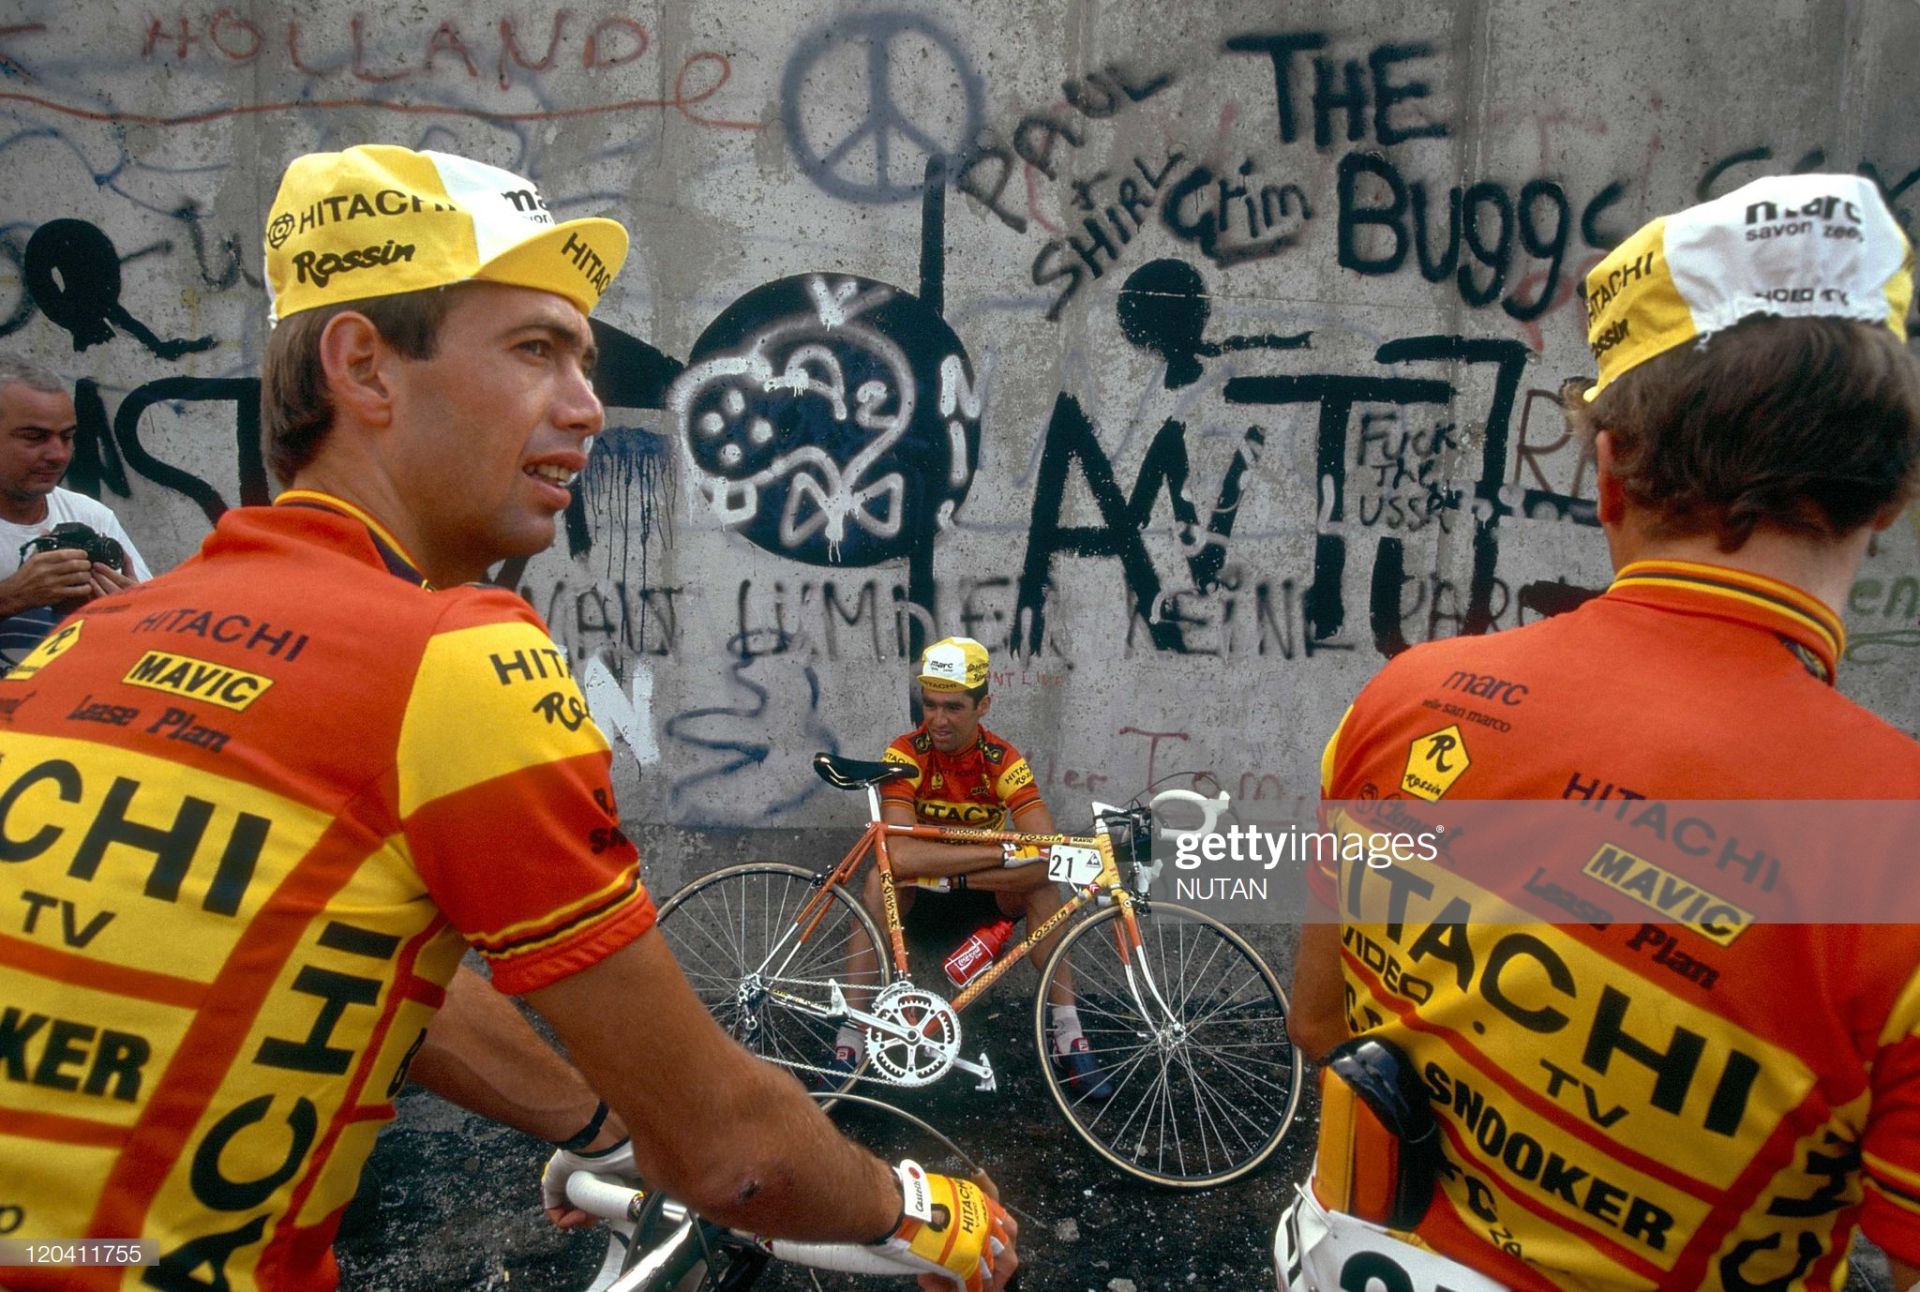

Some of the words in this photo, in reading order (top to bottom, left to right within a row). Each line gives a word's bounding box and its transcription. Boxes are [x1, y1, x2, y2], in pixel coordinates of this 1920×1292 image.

[142, 10, 648, 90] HOLLAND
[1226, 31, 1452, 148] THE
[957, 64, 1178, 234] PAUL
[1745, 221, 1813, 242] savon
[292, 240, 417, 288] Rossin
[131, 608, 310, 662] HITACHI
[130, 654, 259, 704] MAVIC
[1442, 670, 1530, 706] marc
[145, 706, 231, 752] Plan
[1425, 734, 1457, 772] R
[1562, 772, 1780, 892] HITACHI
[1049, 854, 1074, 879] 21
[1589, 846, 1742, 937] MAVIC
[20, 890, 116, 949] TV
[1625, 922, 1721, 990] Plan
[1539, 1059, 1630, 1130] TV
[1424, 1060, 1676, 1252] SNOOKER
